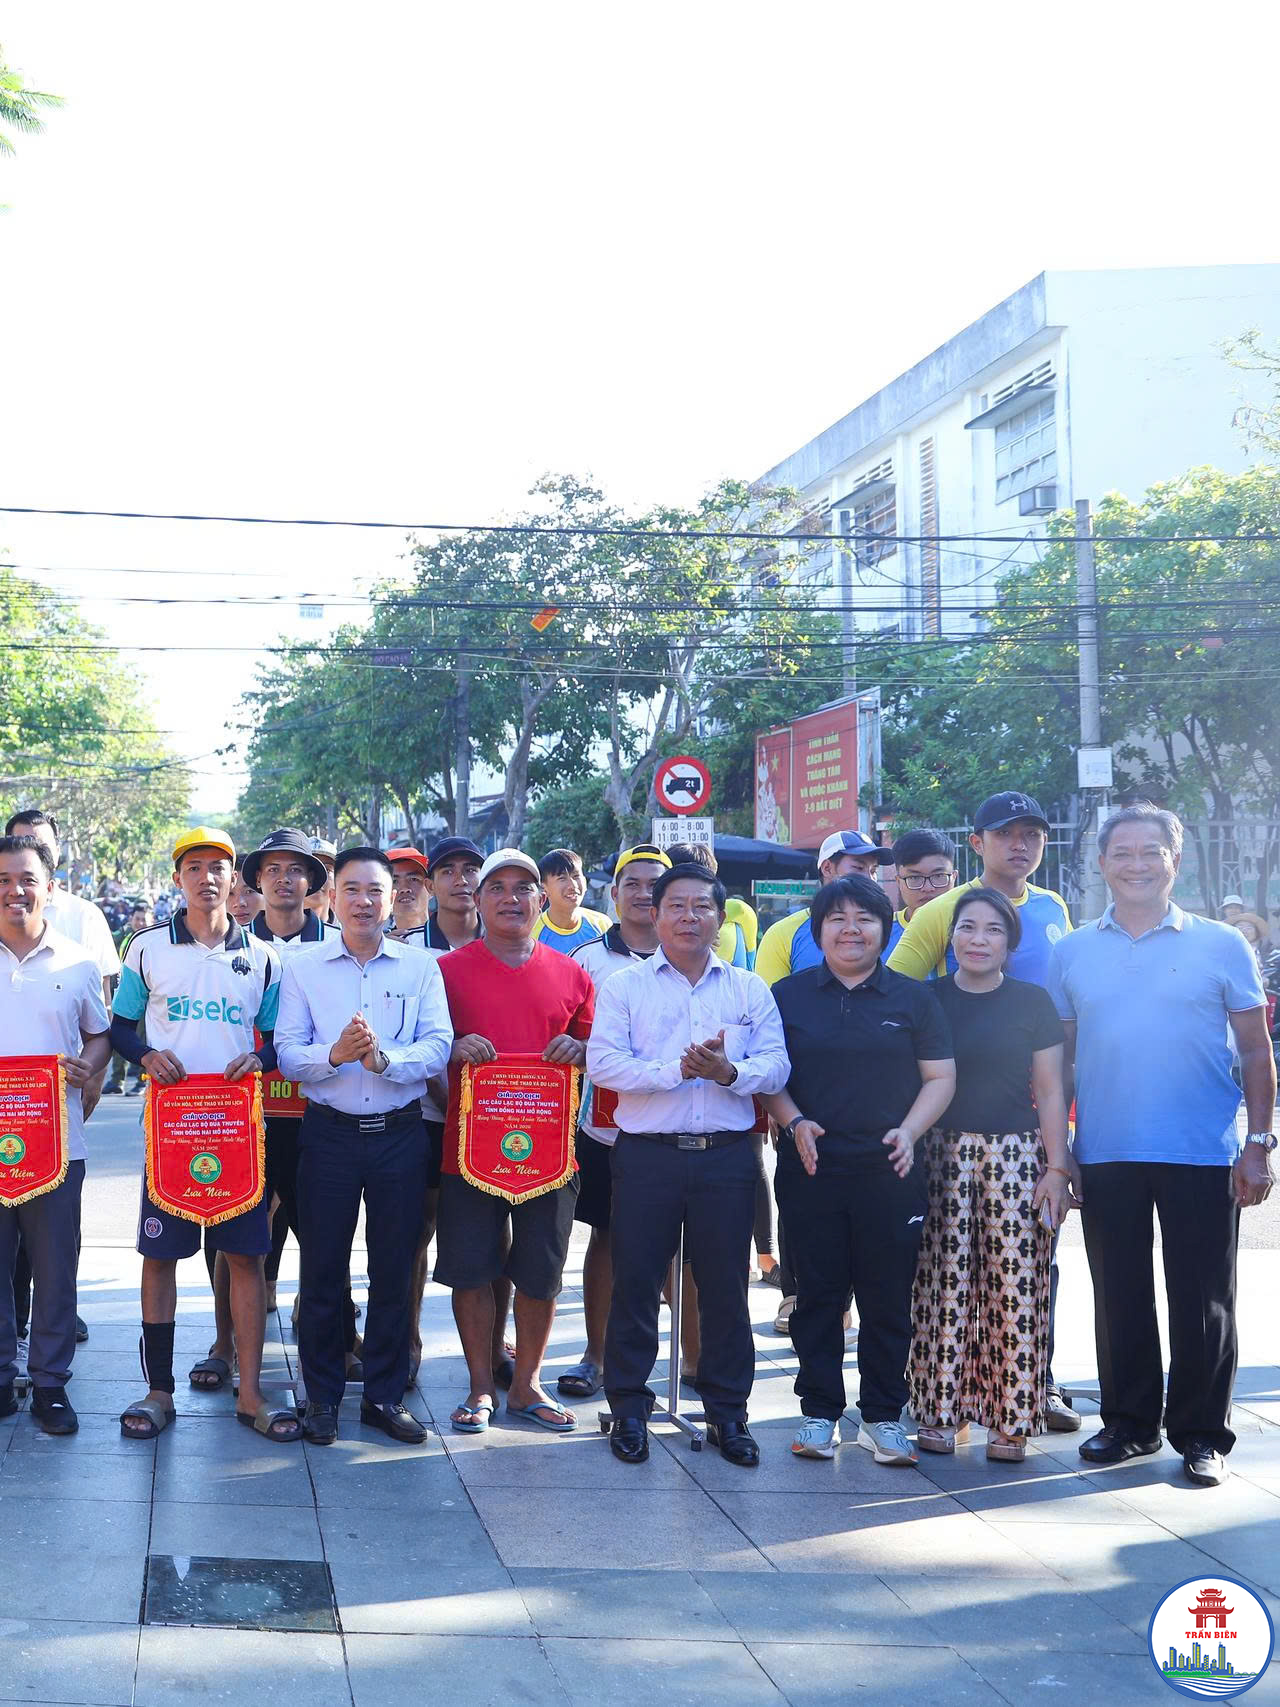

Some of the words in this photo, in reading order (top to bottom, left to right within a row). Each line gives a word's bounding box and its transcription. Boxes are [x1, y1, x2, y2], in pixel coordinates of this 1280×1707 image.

[685, 780, 695, 788] 2t
[661, 822, 678, 831] 6:00
[687, 822, 704, 831] 8:00
[658, 833, 679, 842] 11:00
[688, 833, 709, 841] 13:00
[492, 1164, 512, 1174] Lưu
[515, 1164, 541, 1177] Niệm
[183, 1187, 202, 1197] Lưu
[205, 1187, 231, 1199] Niệm
